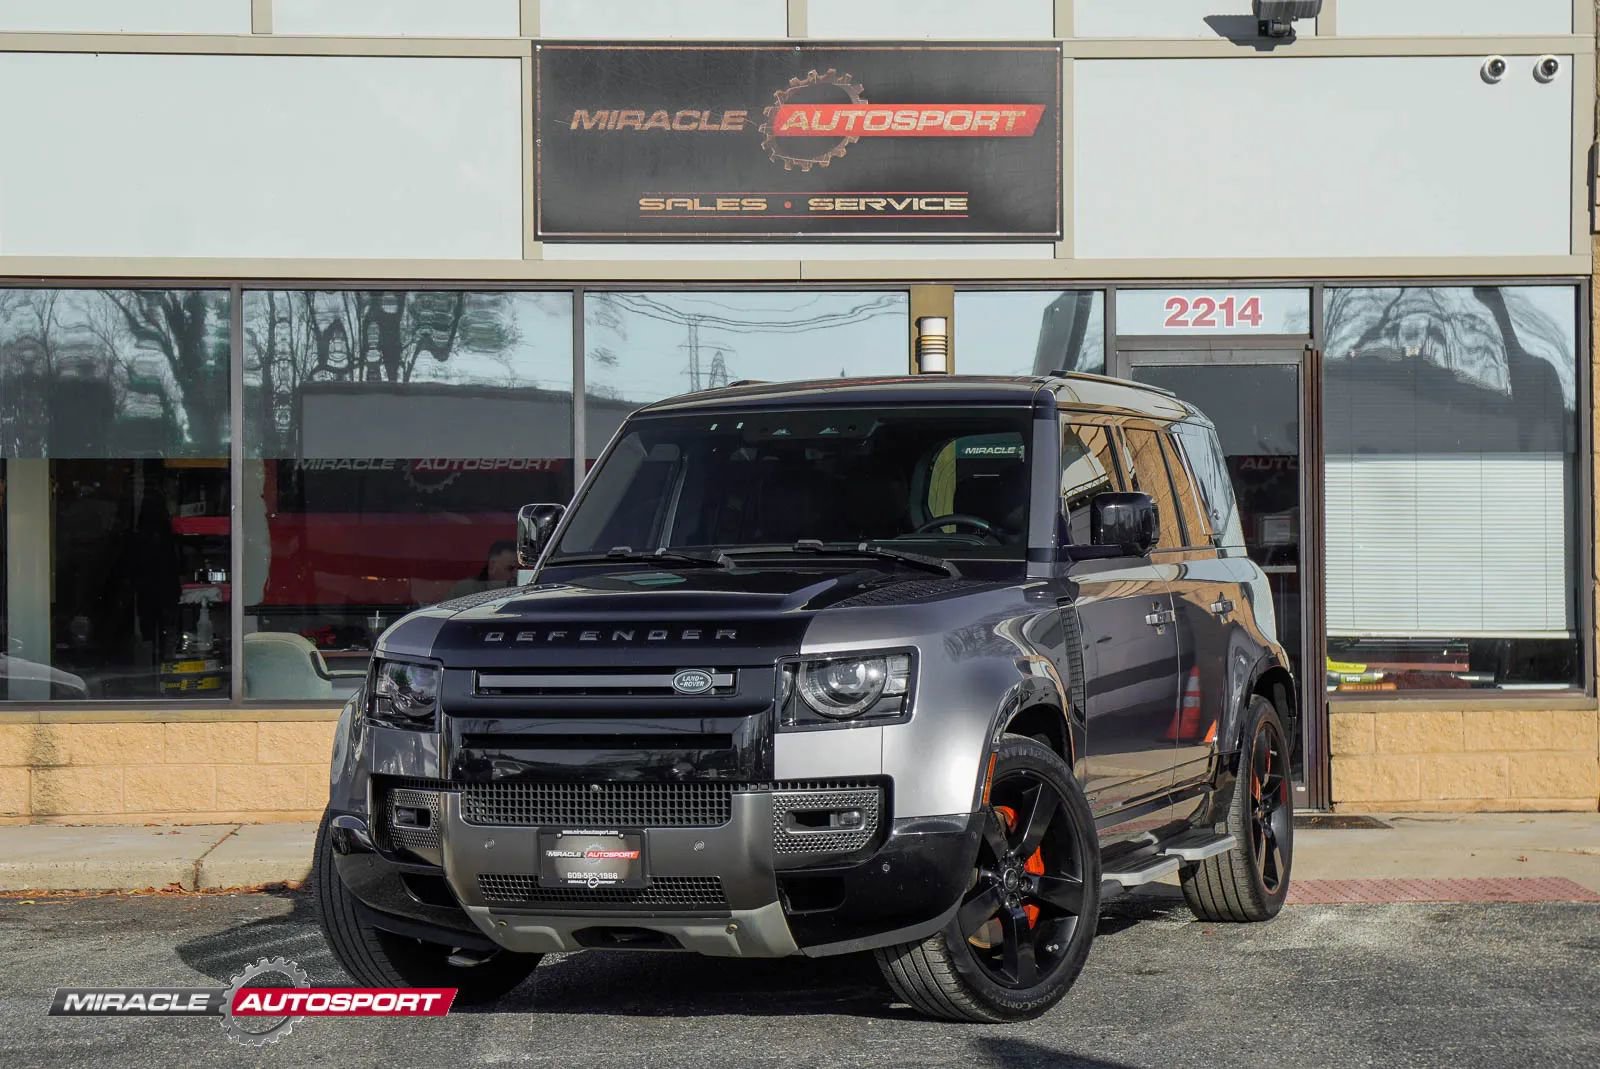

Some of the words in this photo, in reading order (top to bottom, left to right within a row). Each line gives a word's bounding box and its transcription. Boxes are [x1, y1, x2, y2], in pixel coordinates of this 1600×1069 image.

[570, 109, 748, 131] MIRACLE
[780, 109, 1027, 132] AUTOSPORT
[639, 197, 768, 212] SALES
[808, 197, 968, 212] SERVICE
[1164, 296, 1263, 328] 2214
[965, 446, 1017, 454] MIRACLE
[294, 458, 397, 470] MIRACLE
[416, 458, 557, 470] AUTOSPORT
[484, 630, 737, 641] DEFENDER
[547, 850, 582, 858] MIRACLE
[587, 850, 634, 858] AUTOSPORT
